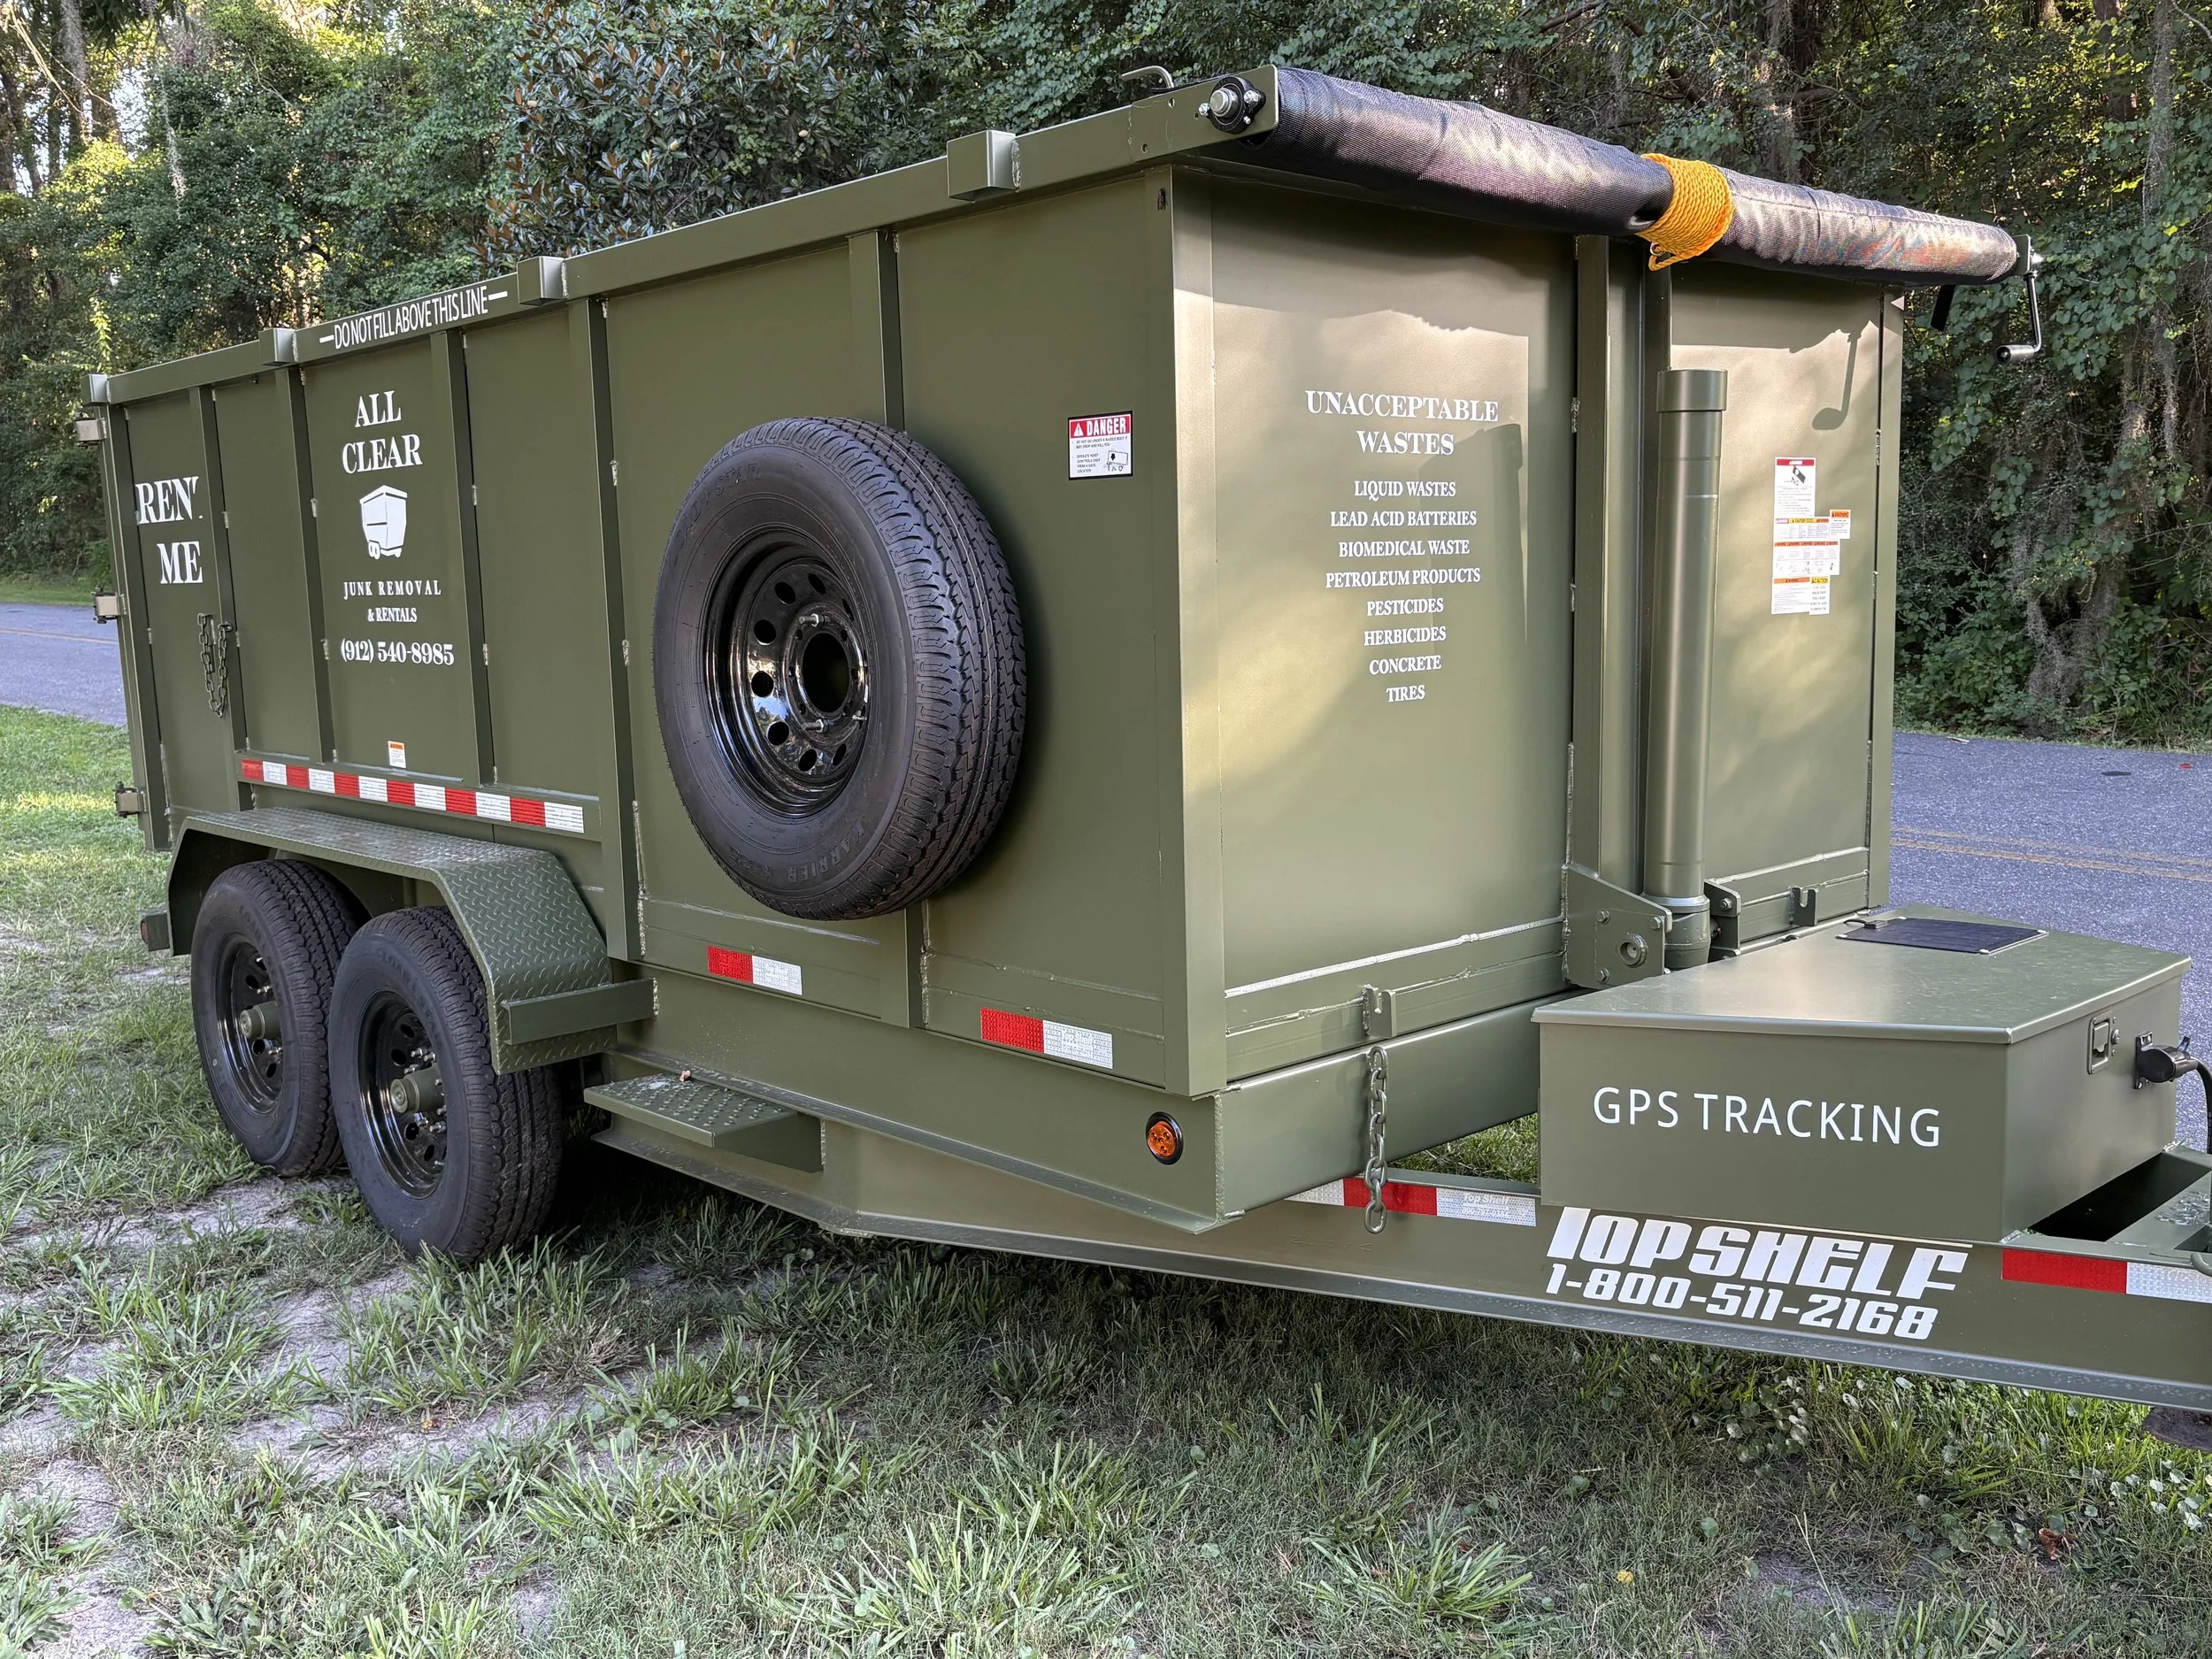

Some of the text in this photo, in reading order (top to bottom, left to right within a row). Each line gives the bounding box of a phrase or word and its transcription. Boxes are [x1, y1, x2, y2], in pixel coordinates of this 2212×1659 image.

[334, 286, 488, 349] DO NOT FILL ABOVE THIS LINE
[355, 390, 402, 427] ALL
[1305, 390, 1499, 423] UNACCEPTABLE
[1087, 417, 1126, 436] DANGER
[342, 434, 423, 474] CLEAR
[1356, 430, 1455, 456] WASTES
[135, 476, 203, 524] REN
[1354, 480, 1456, 502] LIQUID WASTES
[1331, 511, 1477, 527] LEAD ACID BATTERIES
[1339, 539, 1470, 557] BIOMEDICAL WASTE
[157, 541, 203, 584] ME
[1325, 568, 1481, 588] PETROLEUM PRODUCTS
[343, 580, 442, 600] JUNK REMOVAL
[367, 607, 418, 623] & RENTALS
[1366, 597, 1444, 617] PESTICIDES
[1363, 626, 1447, 646] HERBICIDES
[341, 638, 454, 665] (912) 540-8985
[1369, 655, 1441, 675] CONCRETE
[1386, 684, 1425, 703] TIRES
[1594, 1087, 1940, 1148] GPS TRACKING
[1546, 1263, 1938, 1340] 1-800-511-2168
